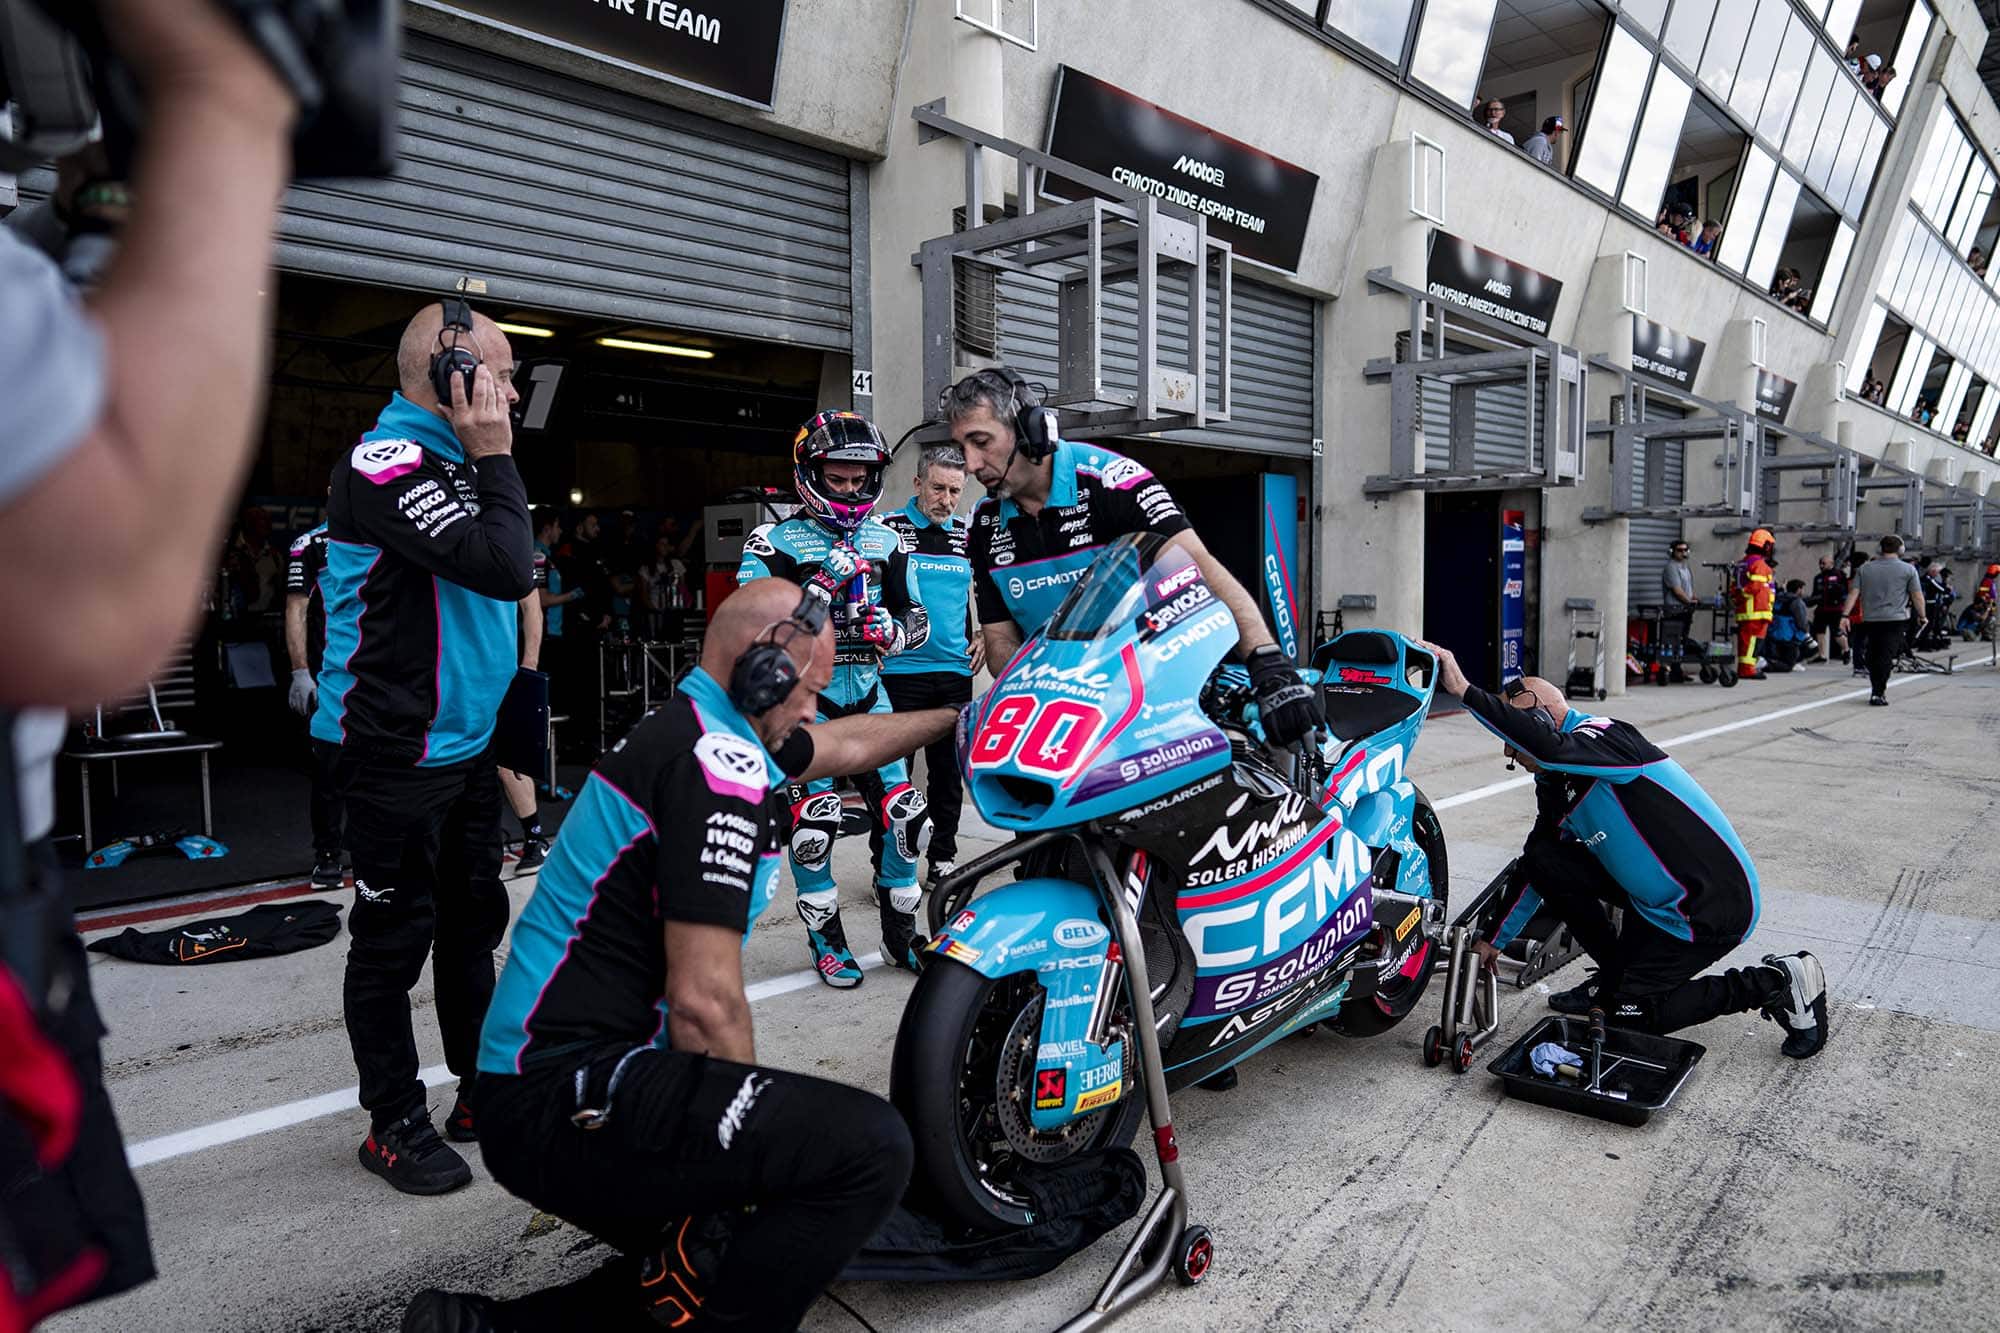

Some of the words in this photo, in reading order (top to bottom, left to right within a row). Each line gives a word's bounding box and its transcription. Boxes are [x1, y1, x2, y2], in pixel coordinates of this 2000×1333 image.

[645, 0, 721, 44] TEAM
[1112, 166, 1165, 198] CFMOTO
[1165, 185, 1198, 210] INDE
[1198, 197, 1234, 222] ASPAR
[1235, 210, 1266, 234] TEAM
[1428, 282, 1469, 307] ONLYFANS
[1467, 296, 1505, 321] AMERICAN
[1503, 306, 1530, 329] RACING
[1529, 316, 1547, 333] TEAM
[855, 373, 873, 391] 41
[405, 489, 447, 519] IVECO
[920, 563, 964, 573] CFMOTO
[1145, 584, 1211, 632] gaviota
[1265, 553, 1297, 659] CFMOTO
[1158, 611, 1230, 662] CFMOTO
[1034, 679, 1106, 700] HISPANIA
[968, 693, 1108, 781] 80
[1141, 736, 1214, 769] solunion
[1144, 774, 1223, 815] POLARCUBE
[707, 829, 754, 855] IVECO
[1186, 859, 1248, 887] SOLER
[1252, 820, 1308, 870] HISPANIA
[1062, 925, 1098, 939] BELL
[1260, 896, 1368, 990] solunion
